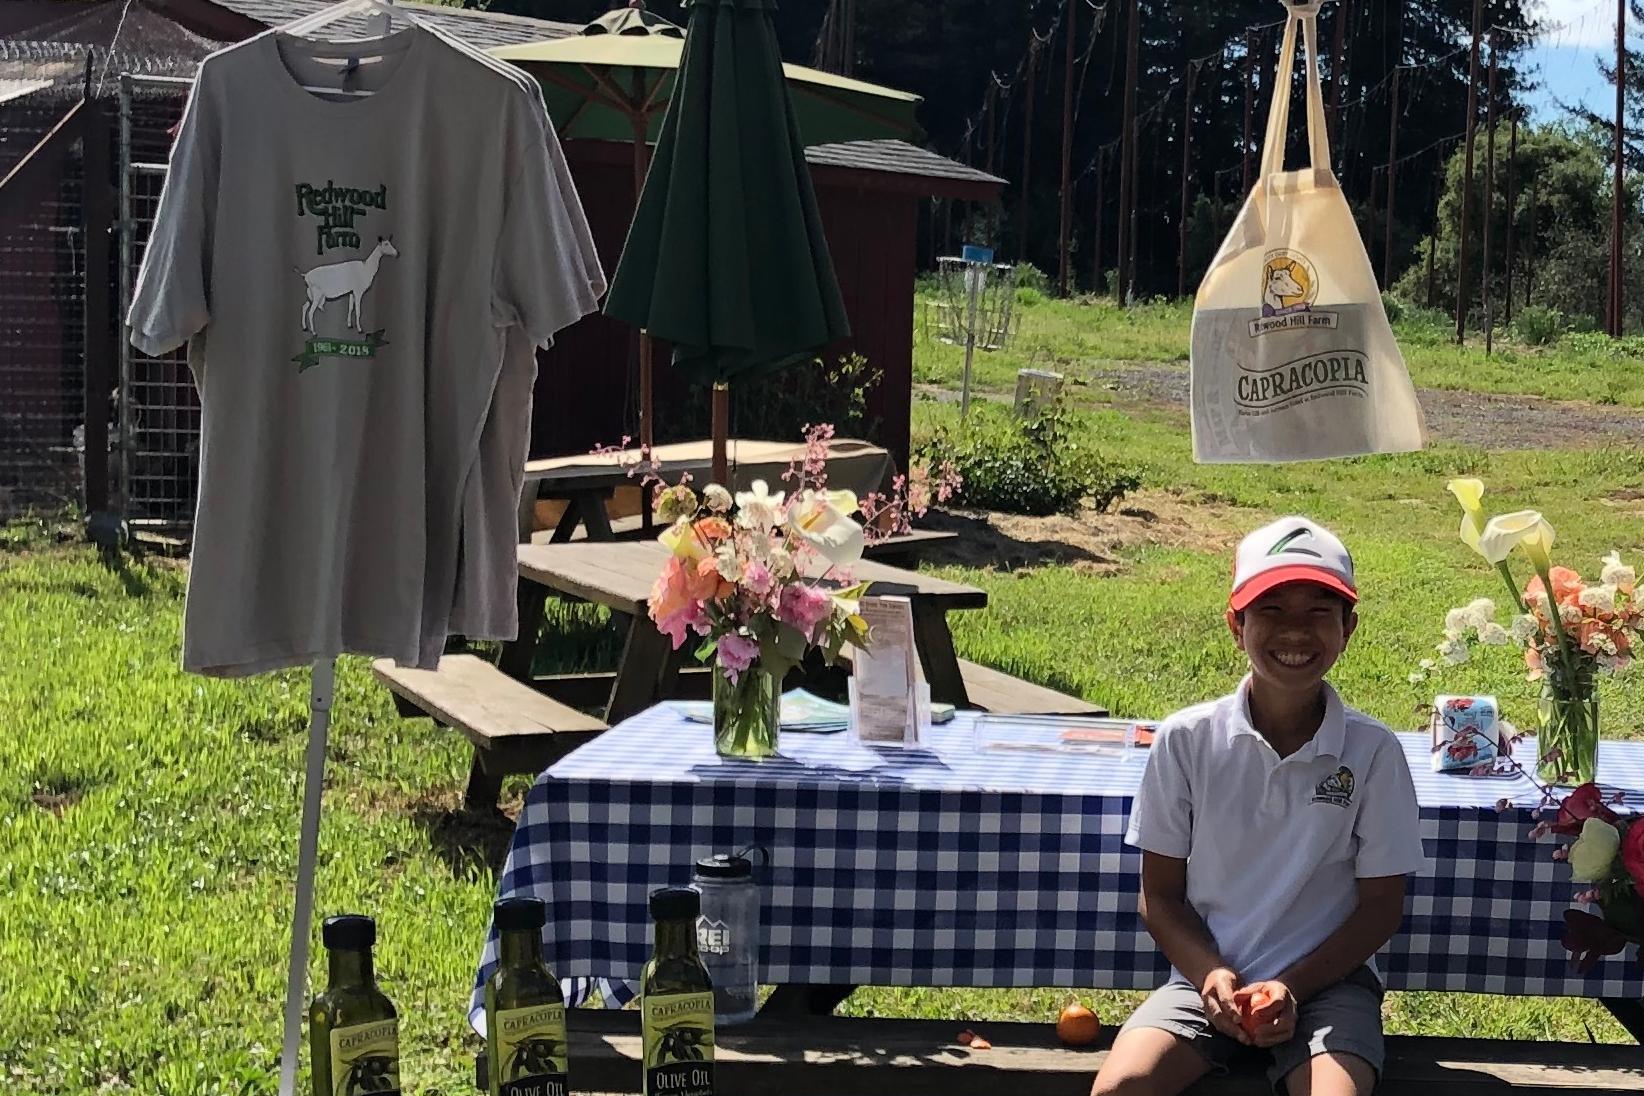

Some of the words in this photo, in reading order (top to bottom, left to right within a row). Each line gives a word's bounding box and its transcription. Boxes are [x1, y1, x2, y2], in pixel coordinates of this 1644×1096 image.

[295, 179, 387, 216] Redwood
[322, 206, 368, 229] Hill
[316, 225, 361, 255] Farm
[1254, 315, 1287, 333] Rwood
[1290, 315, 1305, 327] Hill
[1308, 315, 1331, 327] Farm
[1237, 356, 1369, 401] CAPRACOPIA
[698, 927, 730, 946] REI
[656, 1072, 687, 1090] OLIVE
[692, 1069, 710, 1086] OIL
